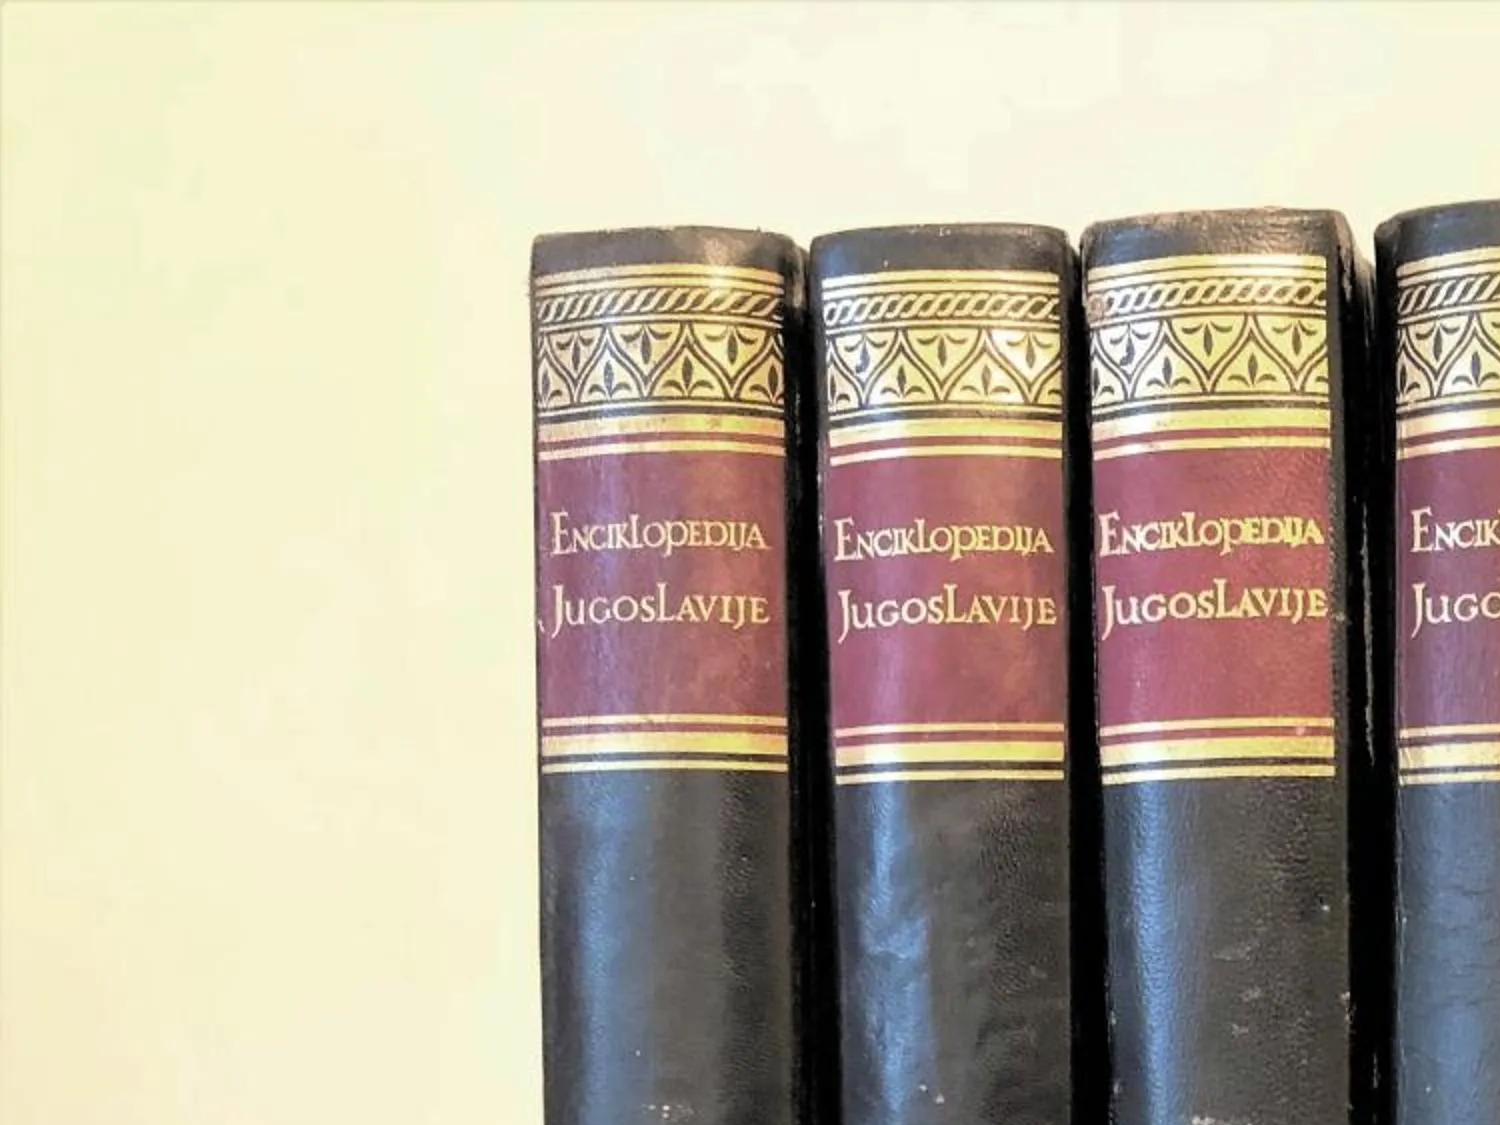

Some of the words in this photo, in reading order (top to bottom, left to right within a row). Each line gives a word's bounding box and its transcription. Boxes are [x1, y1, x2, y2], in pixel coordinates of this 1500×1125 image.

[551, 581, 770, 638] JUGOSLAVIJE
[837, 583, 1057, 643] JUGOSLAVIJE
[1102, 577, 1328, 640] JUGOSLAVIJE
